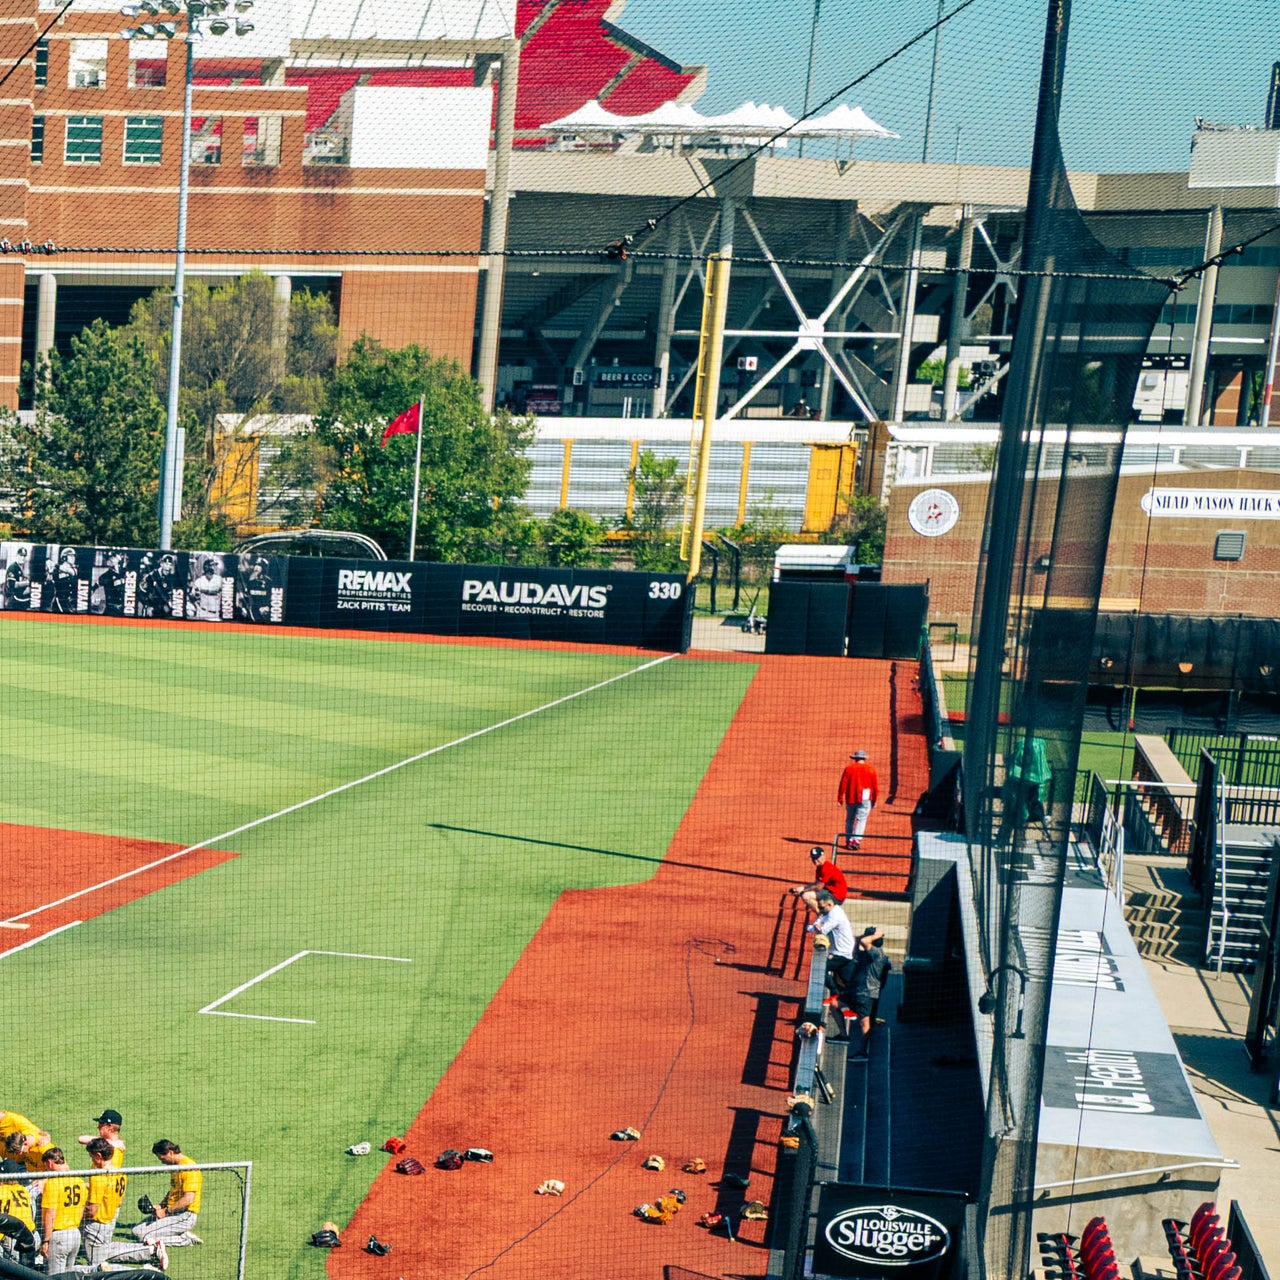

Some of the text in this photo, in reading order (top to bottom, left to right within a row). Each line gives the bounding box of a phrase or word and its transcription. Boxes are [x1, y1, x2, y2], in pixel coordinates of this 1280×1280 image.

[601, 373, 622, 382] BEER
[1156, 495, 1179, 509] SHAD
[1194, 496, 1234, 510] MASON
[125, 571, 137, 615] DETMERS
[338, 569, 413, 593] REMAX
[648, 581, 681, 600] 330
[30, 582, 42, 609] WOLF
[77, 579, 89, 612] WYATT
[172, 588, 184, 618] DAVIS
[222, 576, 234, 620] RUSHING
[270, 587, 283, 622] MOORE
[337, 600, 412, 613] ZACK PITTS TEAM
[461, 603, 605, 618] RECOVER RECONSTRUCT RESTORE
[1065, 1050, 1147, 1092] Health
[63, 1184, 81, 1208] 36
[838, 1219, 935, 1256] Slugger
[863, 1219, 932, 1235] LOUISVILLE
